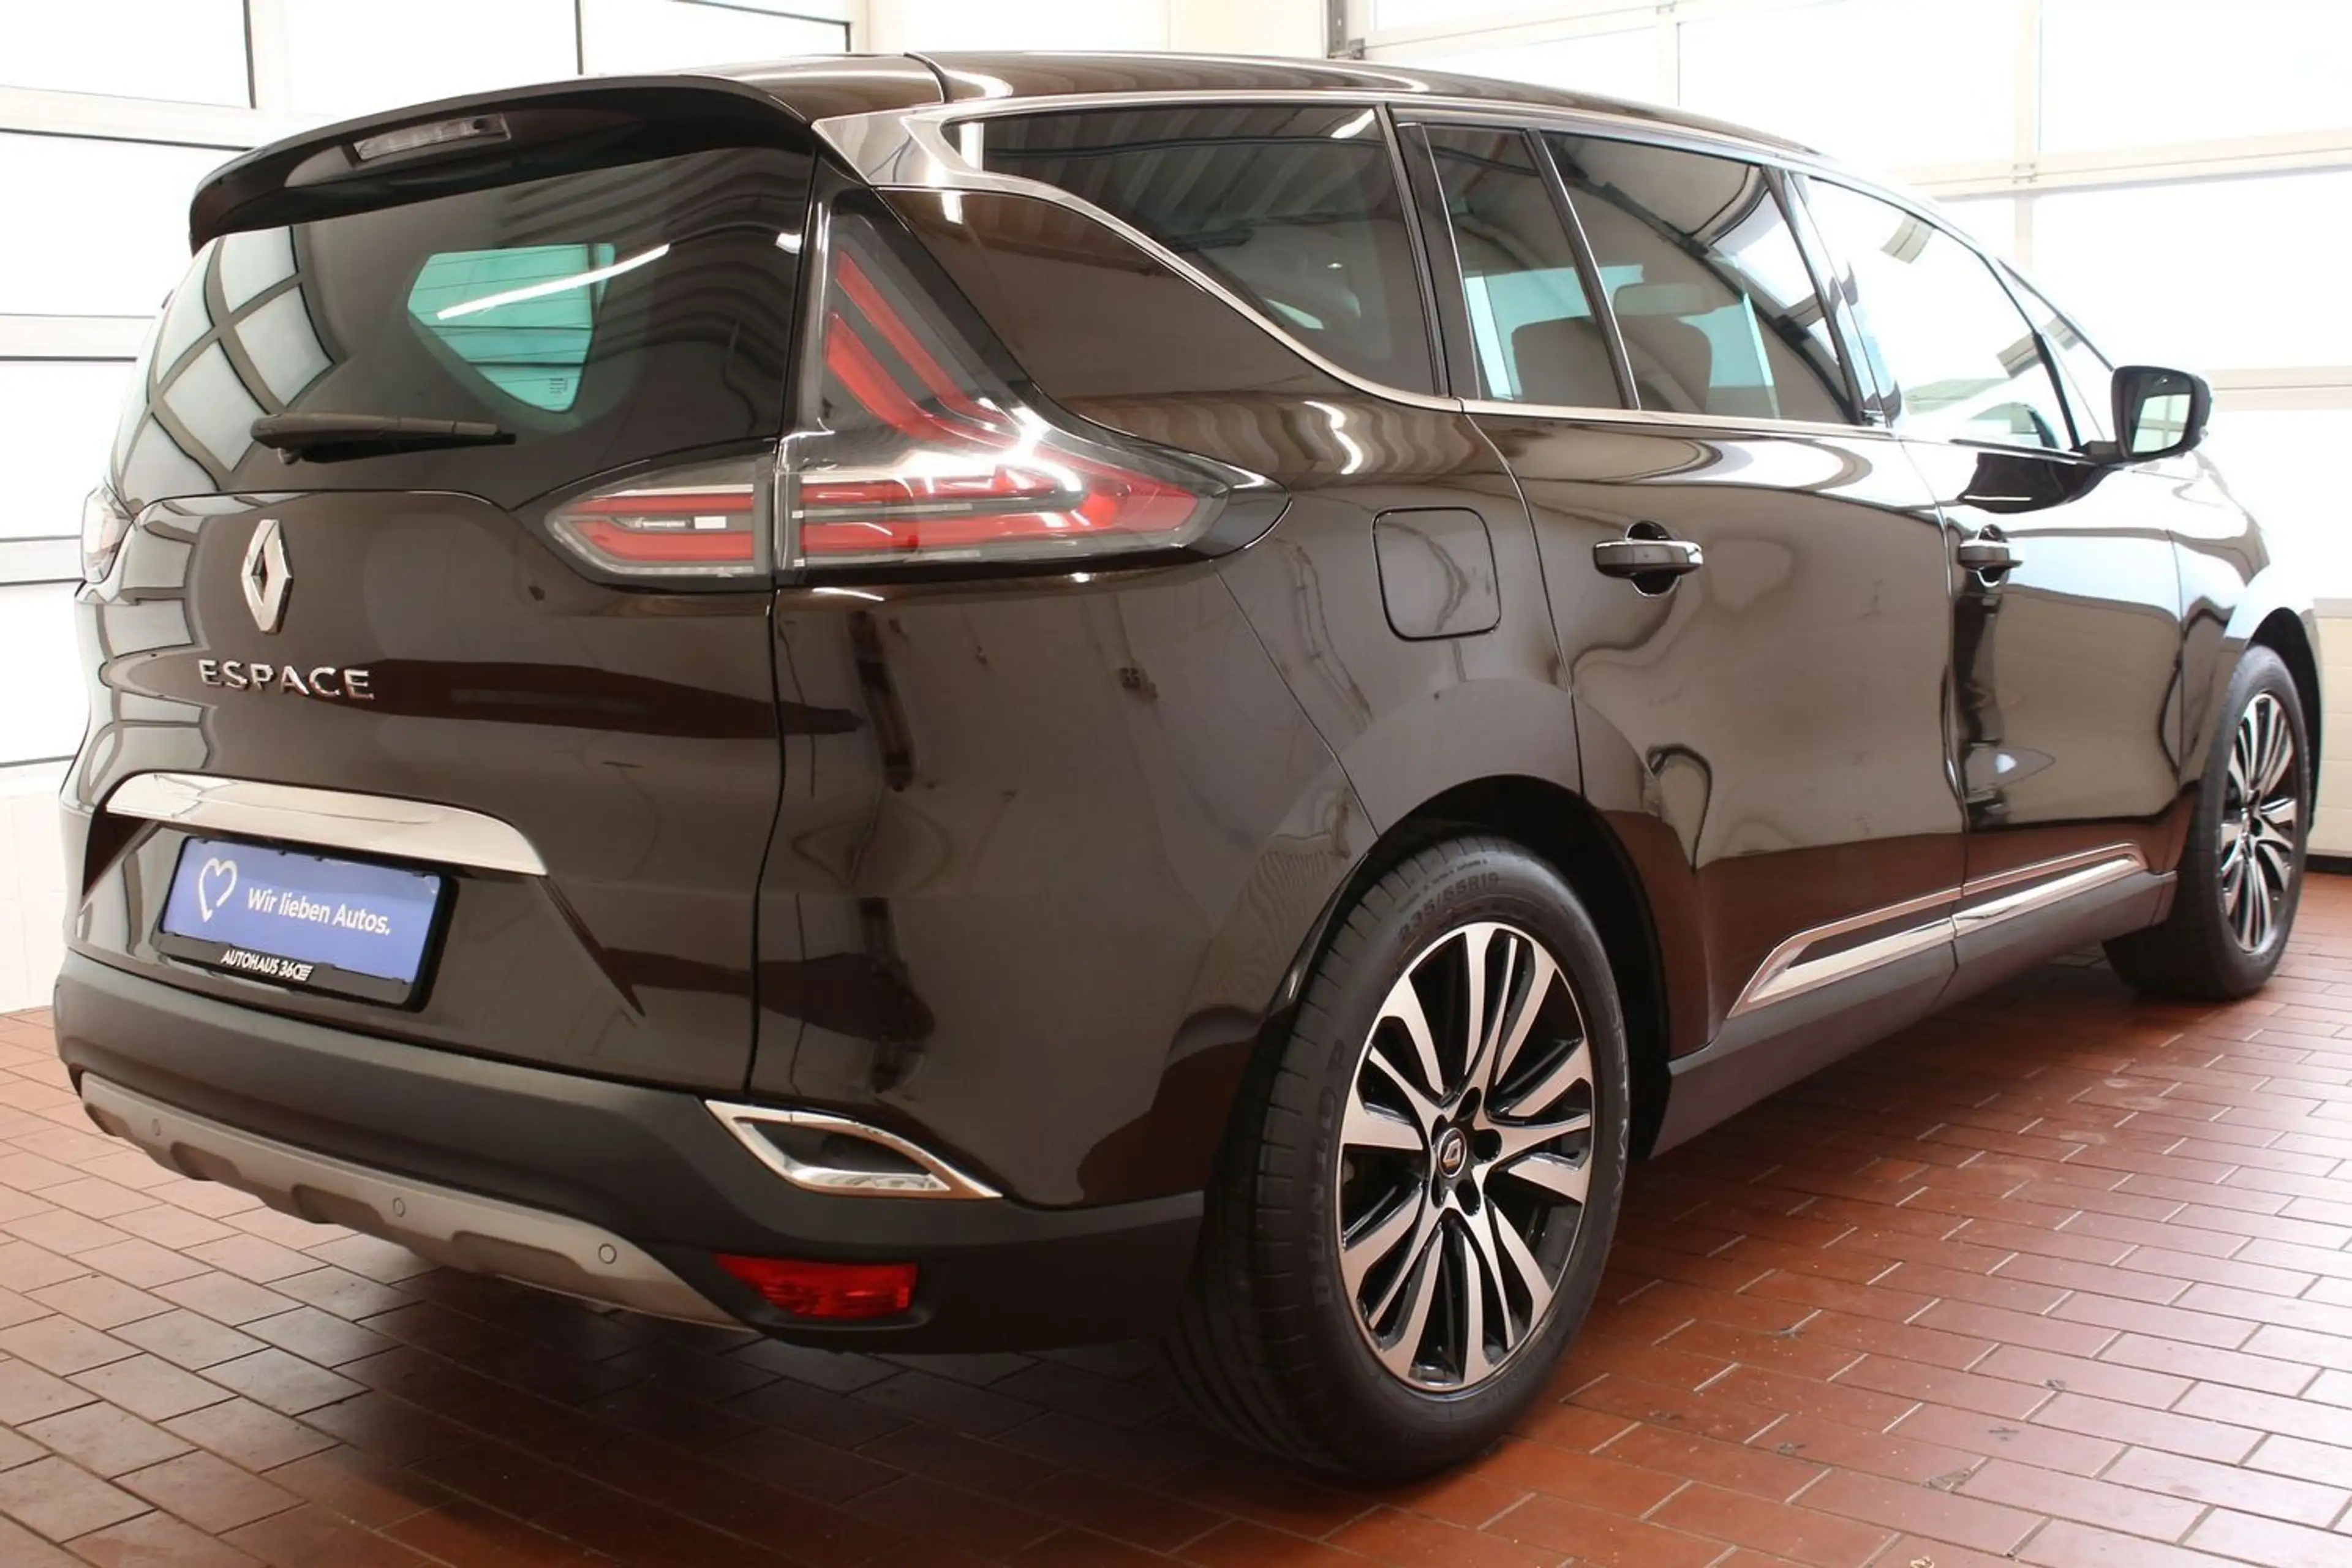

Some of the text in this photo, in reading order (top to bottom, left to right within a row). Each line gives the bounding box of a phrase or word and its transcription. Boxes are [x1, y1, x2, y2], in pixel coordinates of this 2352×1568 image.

[198, 659, 374, 701] ESPACE
[247, 887, 391, 936] Wir lieben Autos.
[220, 949, 281, 976] AUTOHAUS
